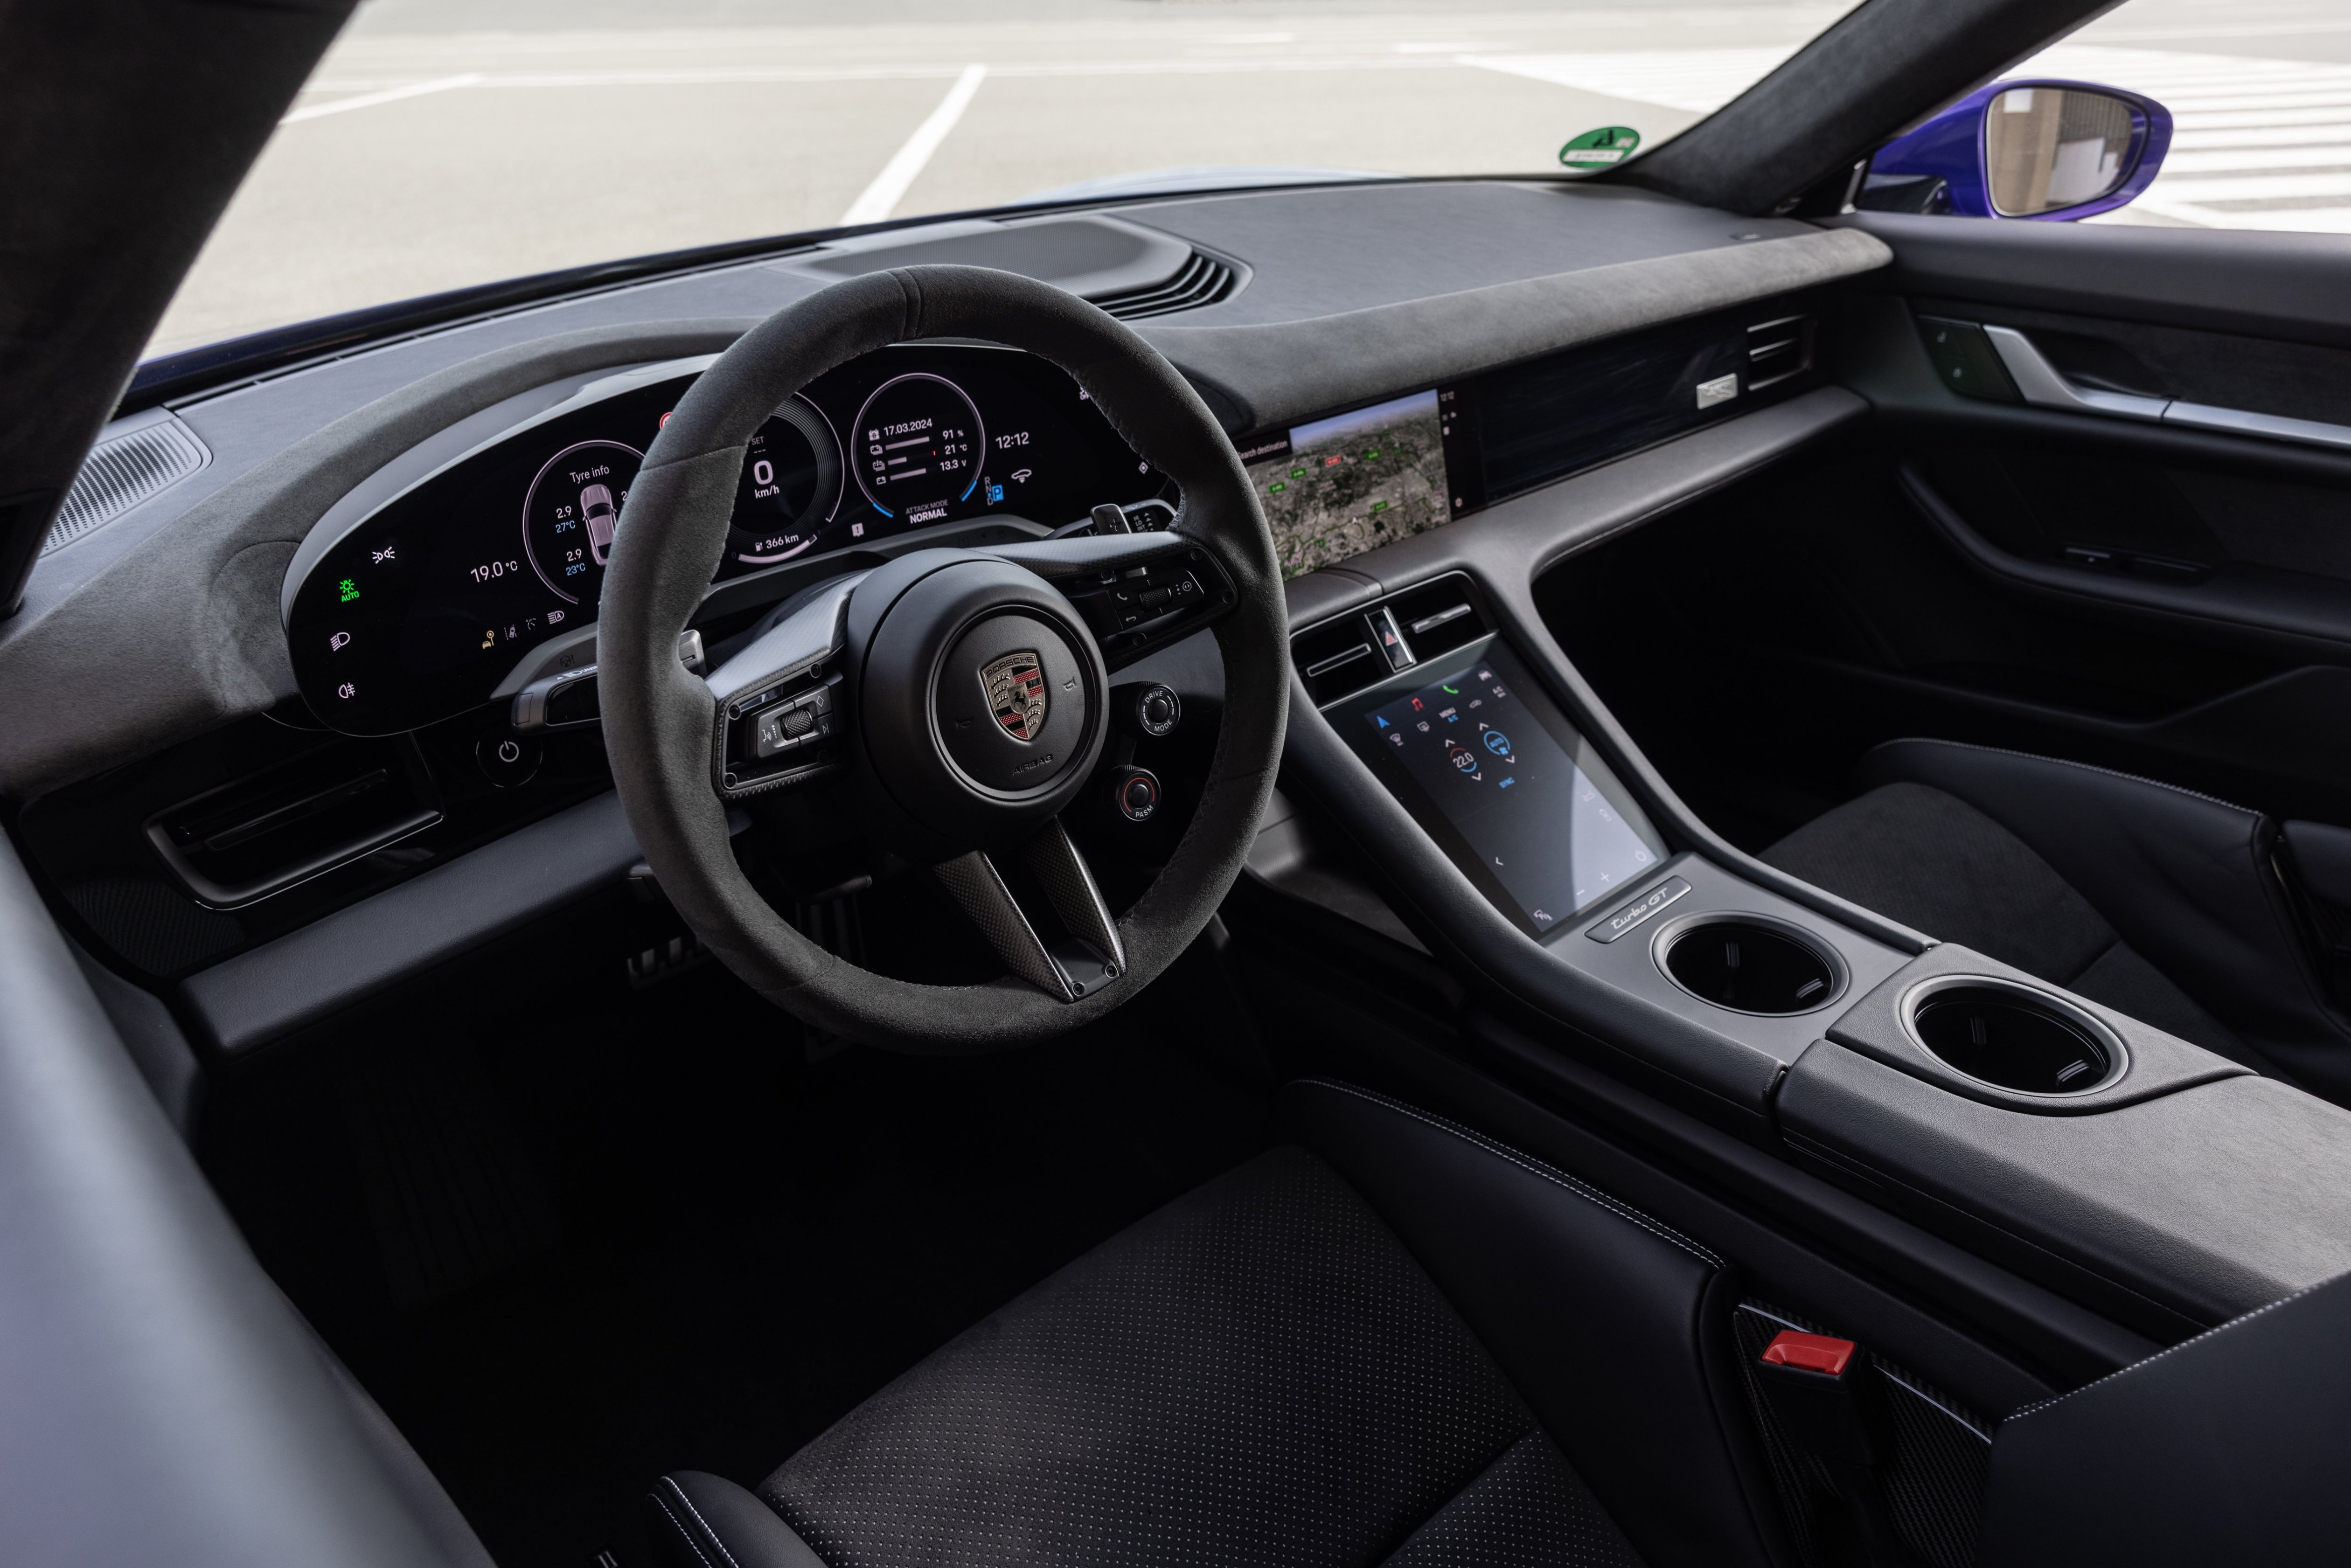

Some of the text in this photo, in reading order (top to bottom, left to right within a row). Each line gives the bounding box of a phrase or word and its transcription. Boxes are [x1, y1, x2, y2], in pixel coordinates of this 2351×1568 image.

[883, 418, 933, 436] 17.03.2024
[751, 436, 764, 445] SET
[943, 429, 954, 440] 91
[995, 432, 1029, 450] 12:12
[945, 444, 967, 455] 21 °C
[1257, 440, 1288, 455] destination
[939, 458, 959, 471] 13.3
[570, 465, 610, 484] Tyre info
[754, 460, 773, 485] 0
[755, 485, 779, 499] km/h
[556, 506, 572, 519] 2.9
[905, 499, 948, 514] ATTACK MODE
[910, 507, 947, 524] NORMAL
[556, 520, 576, 534] 27°C
[765, 534, 799, 549] 366 km
[566, 548, 582, 562] 2.9
[471, 561, 518, 583] 19.0 °C
[566, 562, 586, 576] 23°C
[341, 591, 360, 602] AUTO
[986, 656, 1035, 678] PORSCHE
[1008, 683, 1025, 693] STUTTGART
[1145, 690, 1163, 703] DRIVE
[1439, 707, 1456, 718] MENU
[1155, 719, 1172, 732] MODE
[1012, 754, 1053, 776] AIRBAG
[1453, 752, 1474, 768] 22.0
[1135, 805, 1154, 818] PASM
[1611, 887, 1668, 930] turbo GT
